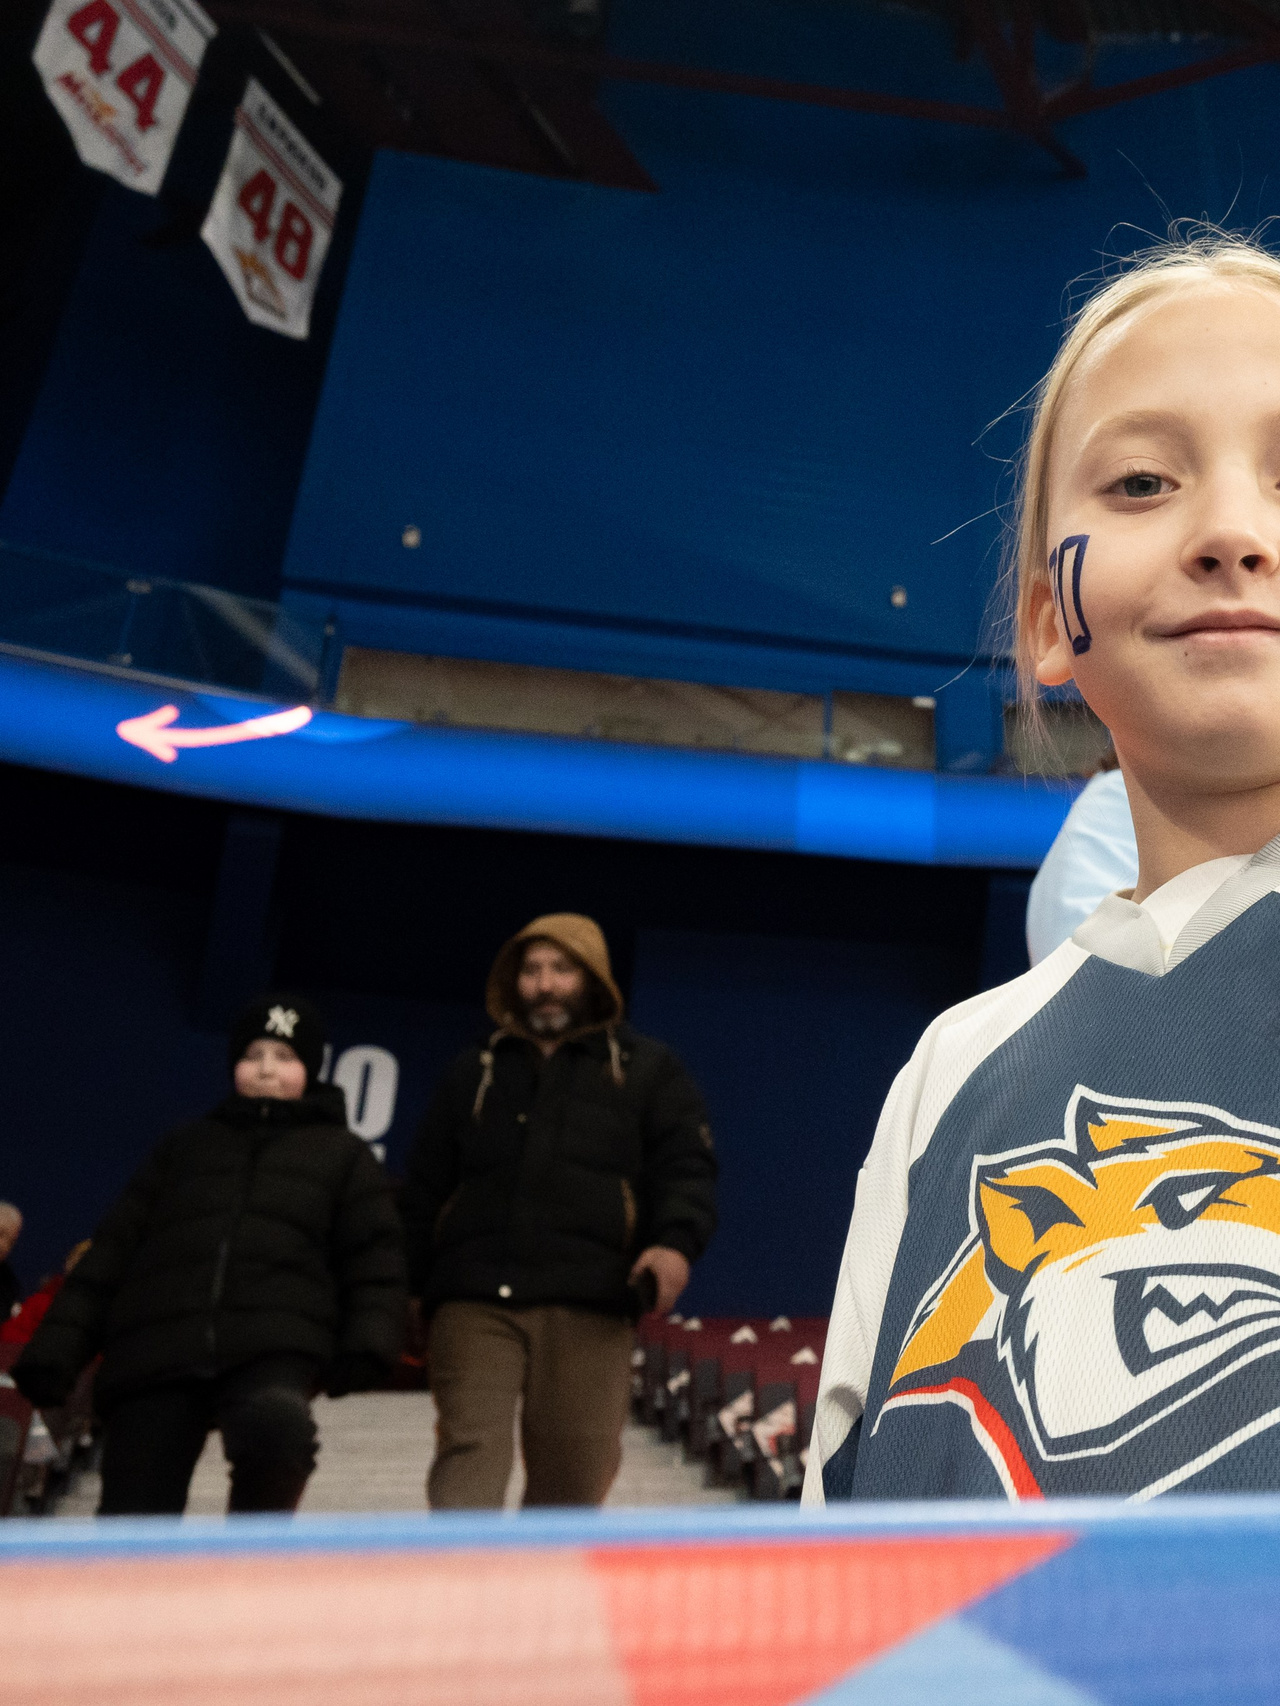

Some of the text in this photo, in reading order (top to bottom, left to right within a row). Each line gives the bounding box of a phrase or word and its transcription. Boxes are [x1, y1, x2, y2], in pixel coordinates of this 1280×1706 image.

[67, 0, 166, 132] 44
[238, 169, 314, 281] 48
[264, 1004, 300, 1038] NY
[317, 1043, 400, 1142] 0
